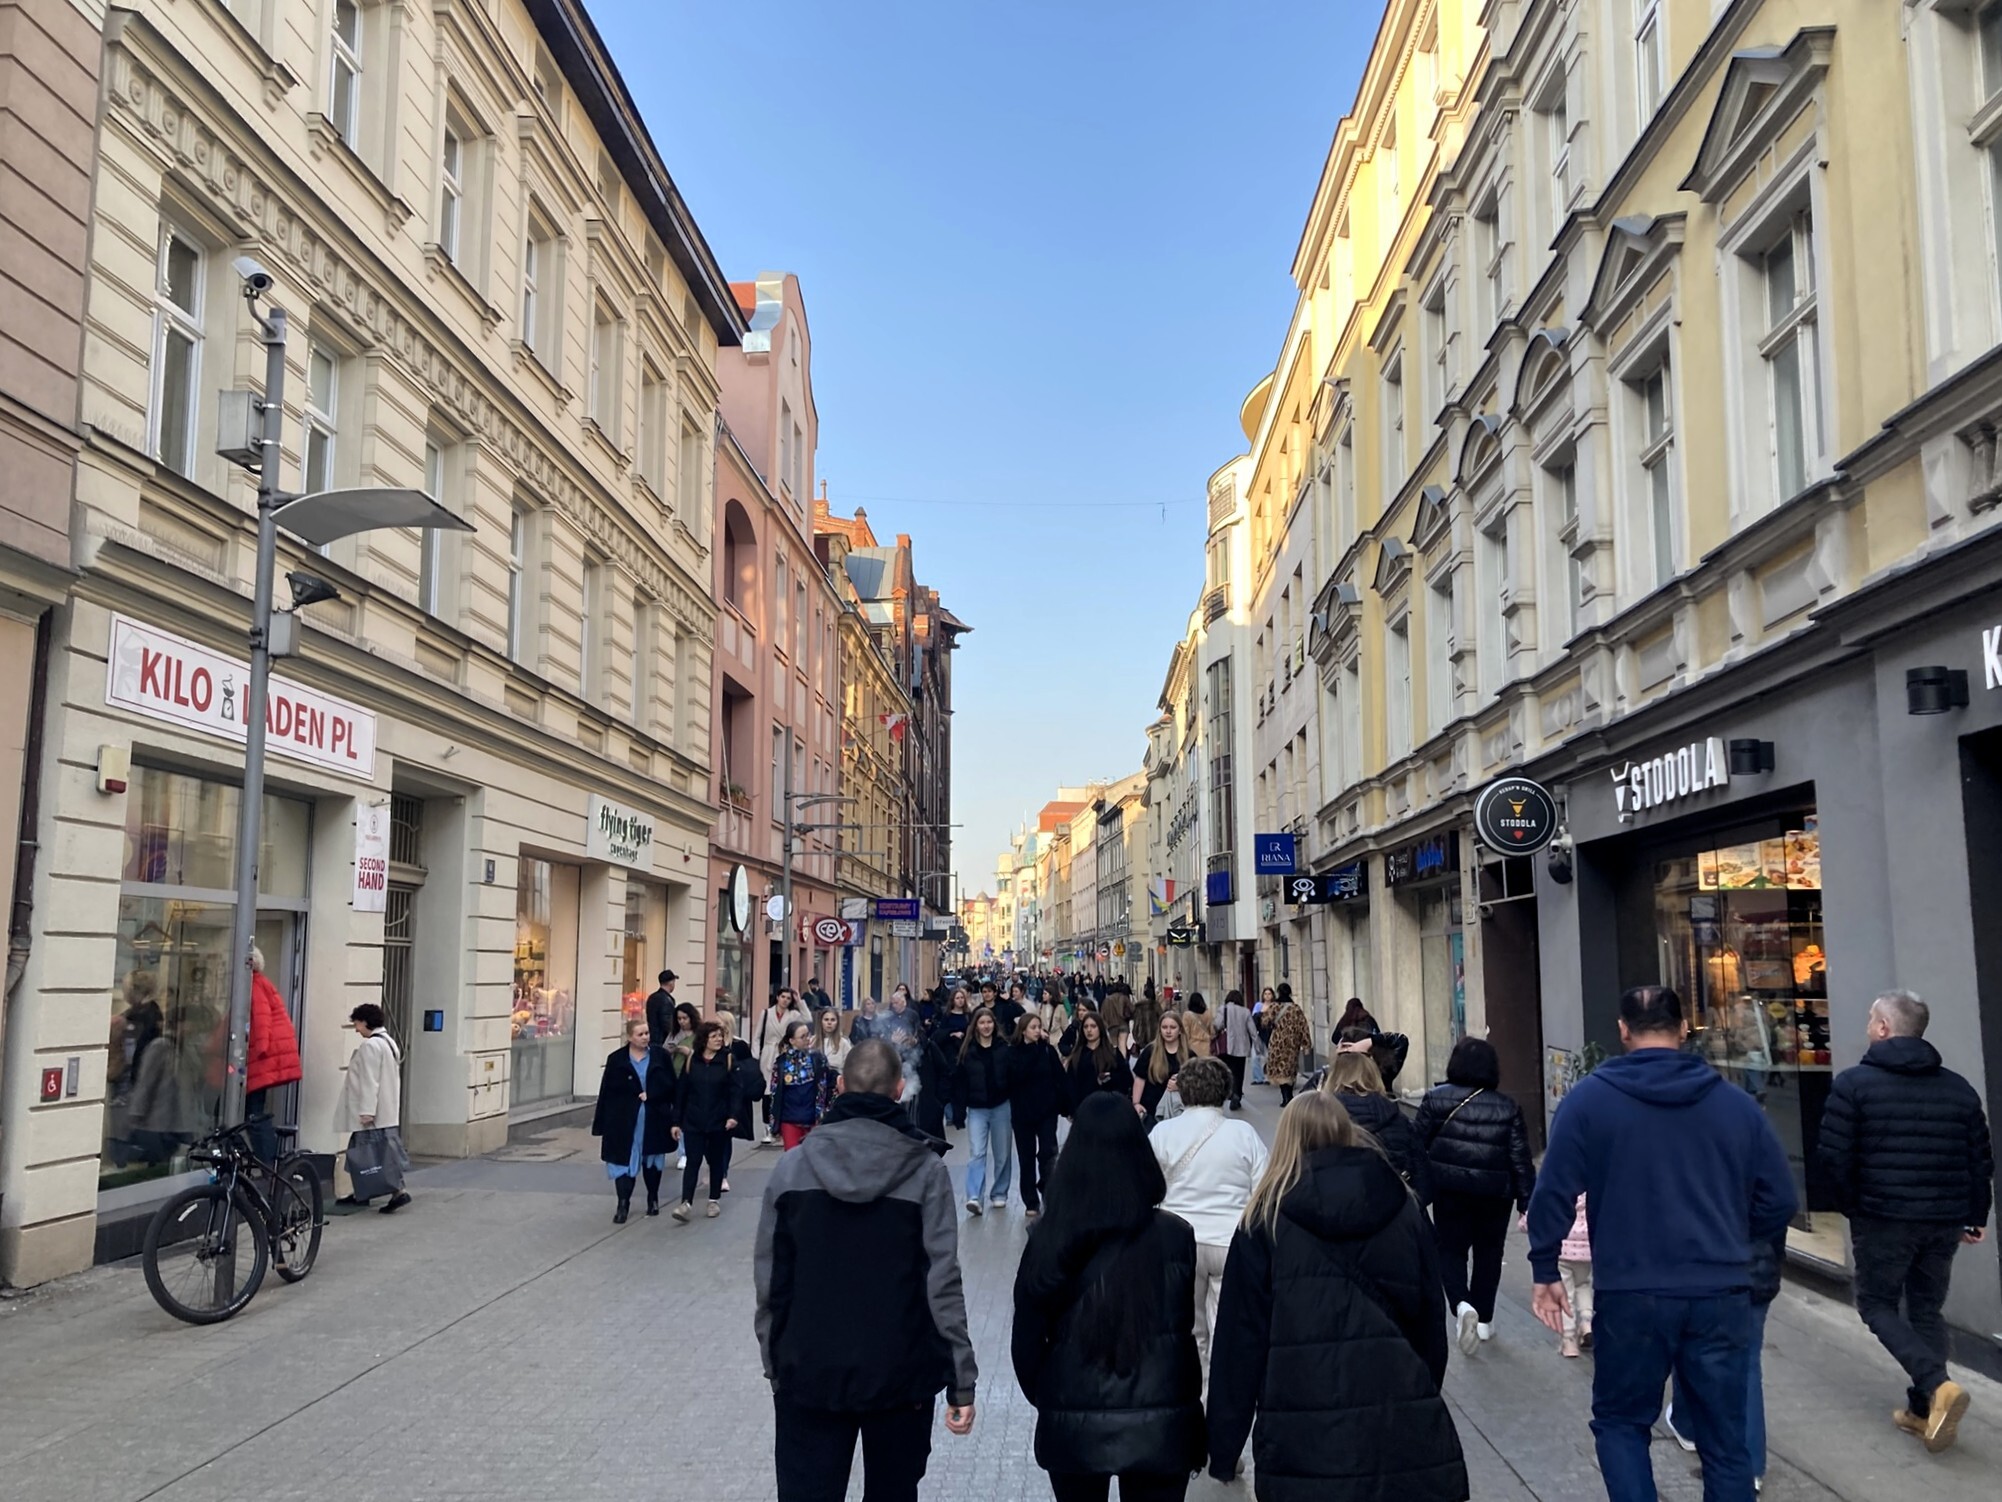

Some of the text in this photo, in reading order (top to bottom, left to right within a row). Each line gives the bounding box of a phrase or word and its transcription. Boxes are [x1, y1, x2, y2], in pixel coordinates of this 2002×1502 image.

[140, 647, 213, 712] KILO
[331, 716, 358, 760] PL
[1631, 737, 1724, 811] STODOLA
[600, 804, 652, 847] flying tiger
[1500, 819, 1537, 828] STODOLA
[359, 856, 386, 872] SECOND
[1261, 853, 1291, 862] RIANA
[358, 871, 385, 891] HAND
